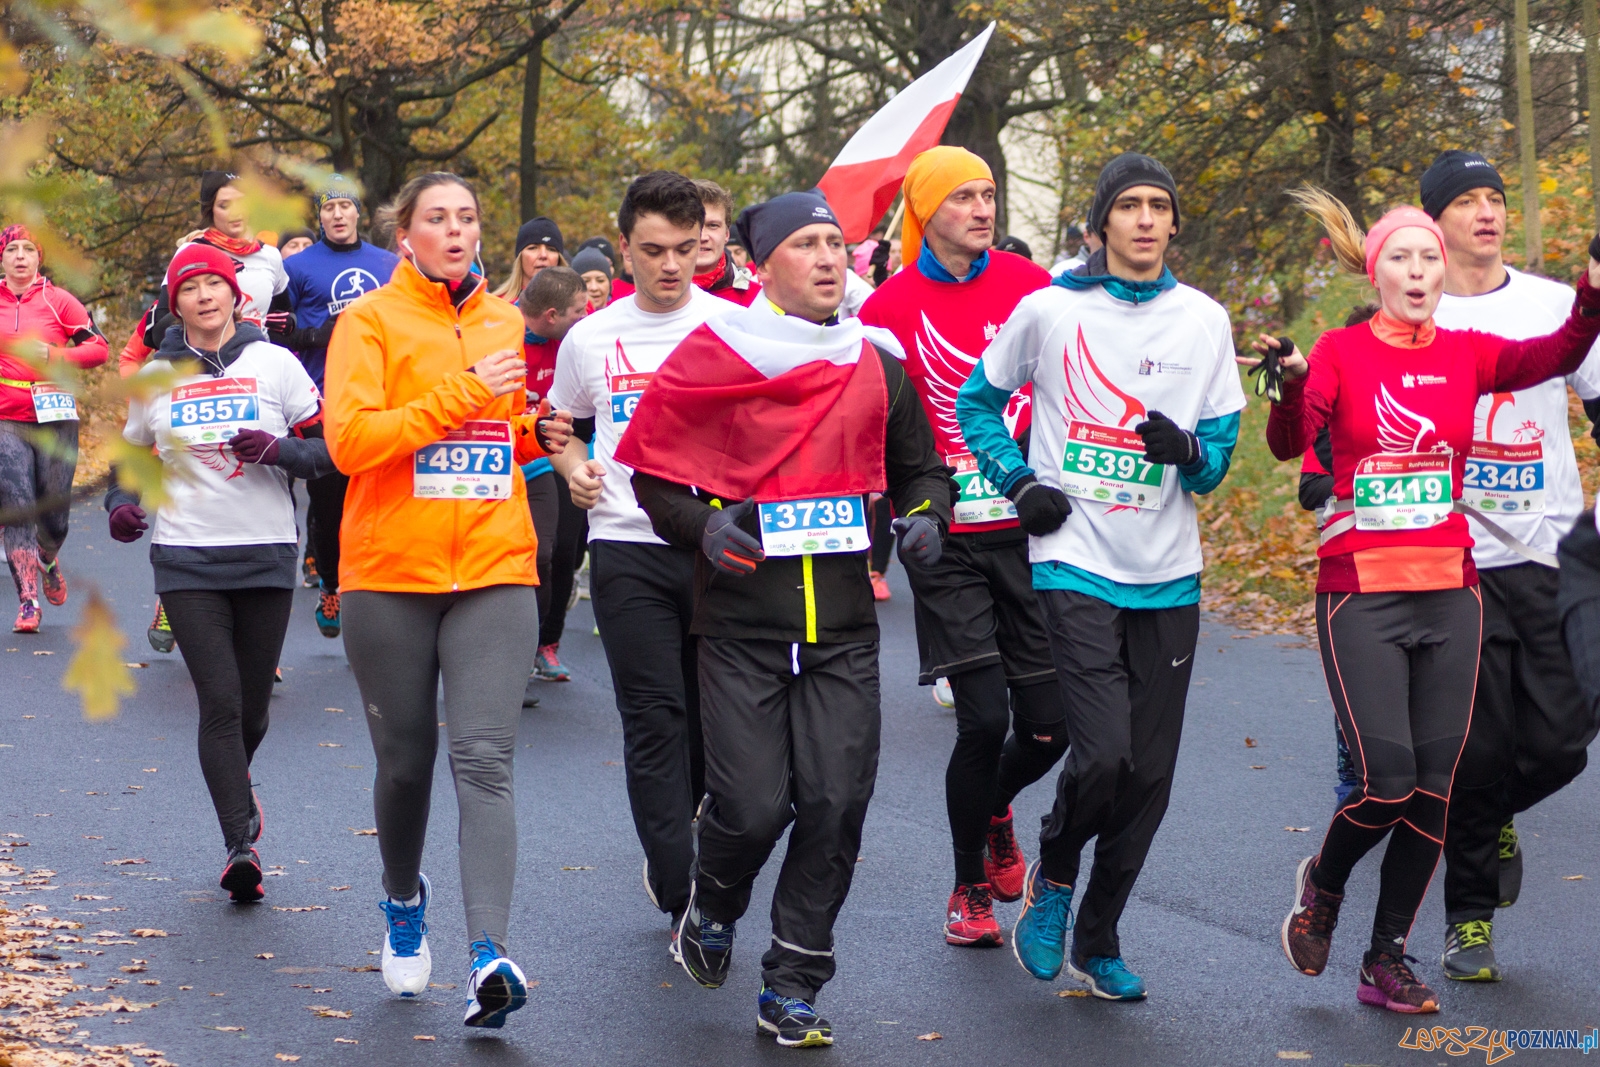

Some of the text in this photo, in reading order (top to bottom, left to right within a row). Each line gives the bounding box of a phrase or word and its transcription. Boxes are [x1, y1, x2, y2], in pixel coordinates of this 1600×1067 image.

[41, 395, 73, 409] 2126
[172, 398, 249, 424] E 8557
[613, 404, 620, 413] E
[418, 447, 504, 472] E 4973
[1066, 448, 1154, 482] C 5397
[1100, 480, 1124, 488] Konrad
[1463, 463, 1536, 489] 2346
[1357, 477, 1442, 504] C 3419
[764, 500, 853, 529] E 3739
